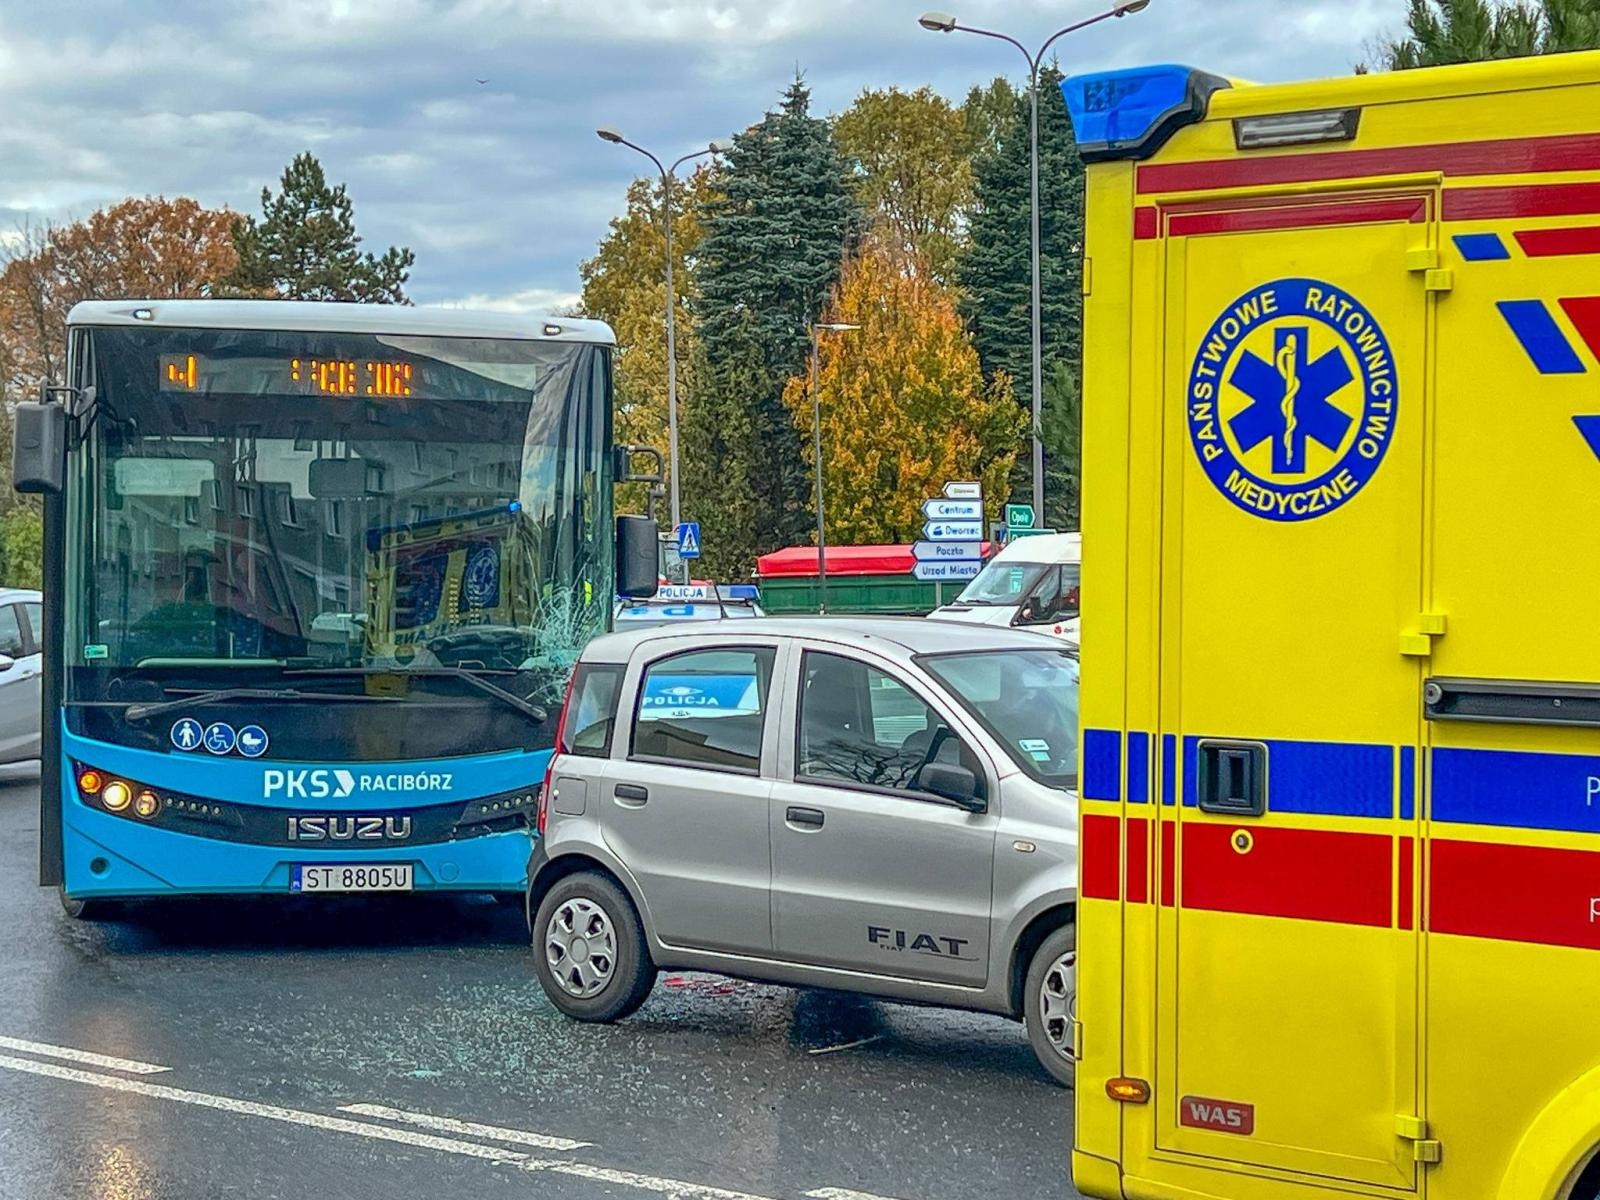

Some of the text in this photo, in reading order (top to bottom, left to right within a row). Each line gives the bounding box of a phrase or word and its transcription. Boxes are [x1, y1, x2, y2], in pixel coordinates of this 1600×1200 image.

[1189, 289, 1278, 462] PAŃSTWOWE
[1305, 287, 1392, 460] RATOWNICTWO
[1223, 468, 1359, 515] MEDYCZNE
[938, 505, 974, 515] Centrum
[936, 546, 964, 556] Poczta
[659, 586, 704, 597] POLICJA
[642, 696, 719, 706] POLICJA
[263, 769, 453, 798] PKS RACIBÓRZ
[288, 817, 411, 840] ISUZU
[306, 868, 334, 888] ST
[341, 867, 407, 888] 8805U
[867, 926, 968, 955] FIAT
[1190, 1103, 1241, 1127] WAS
